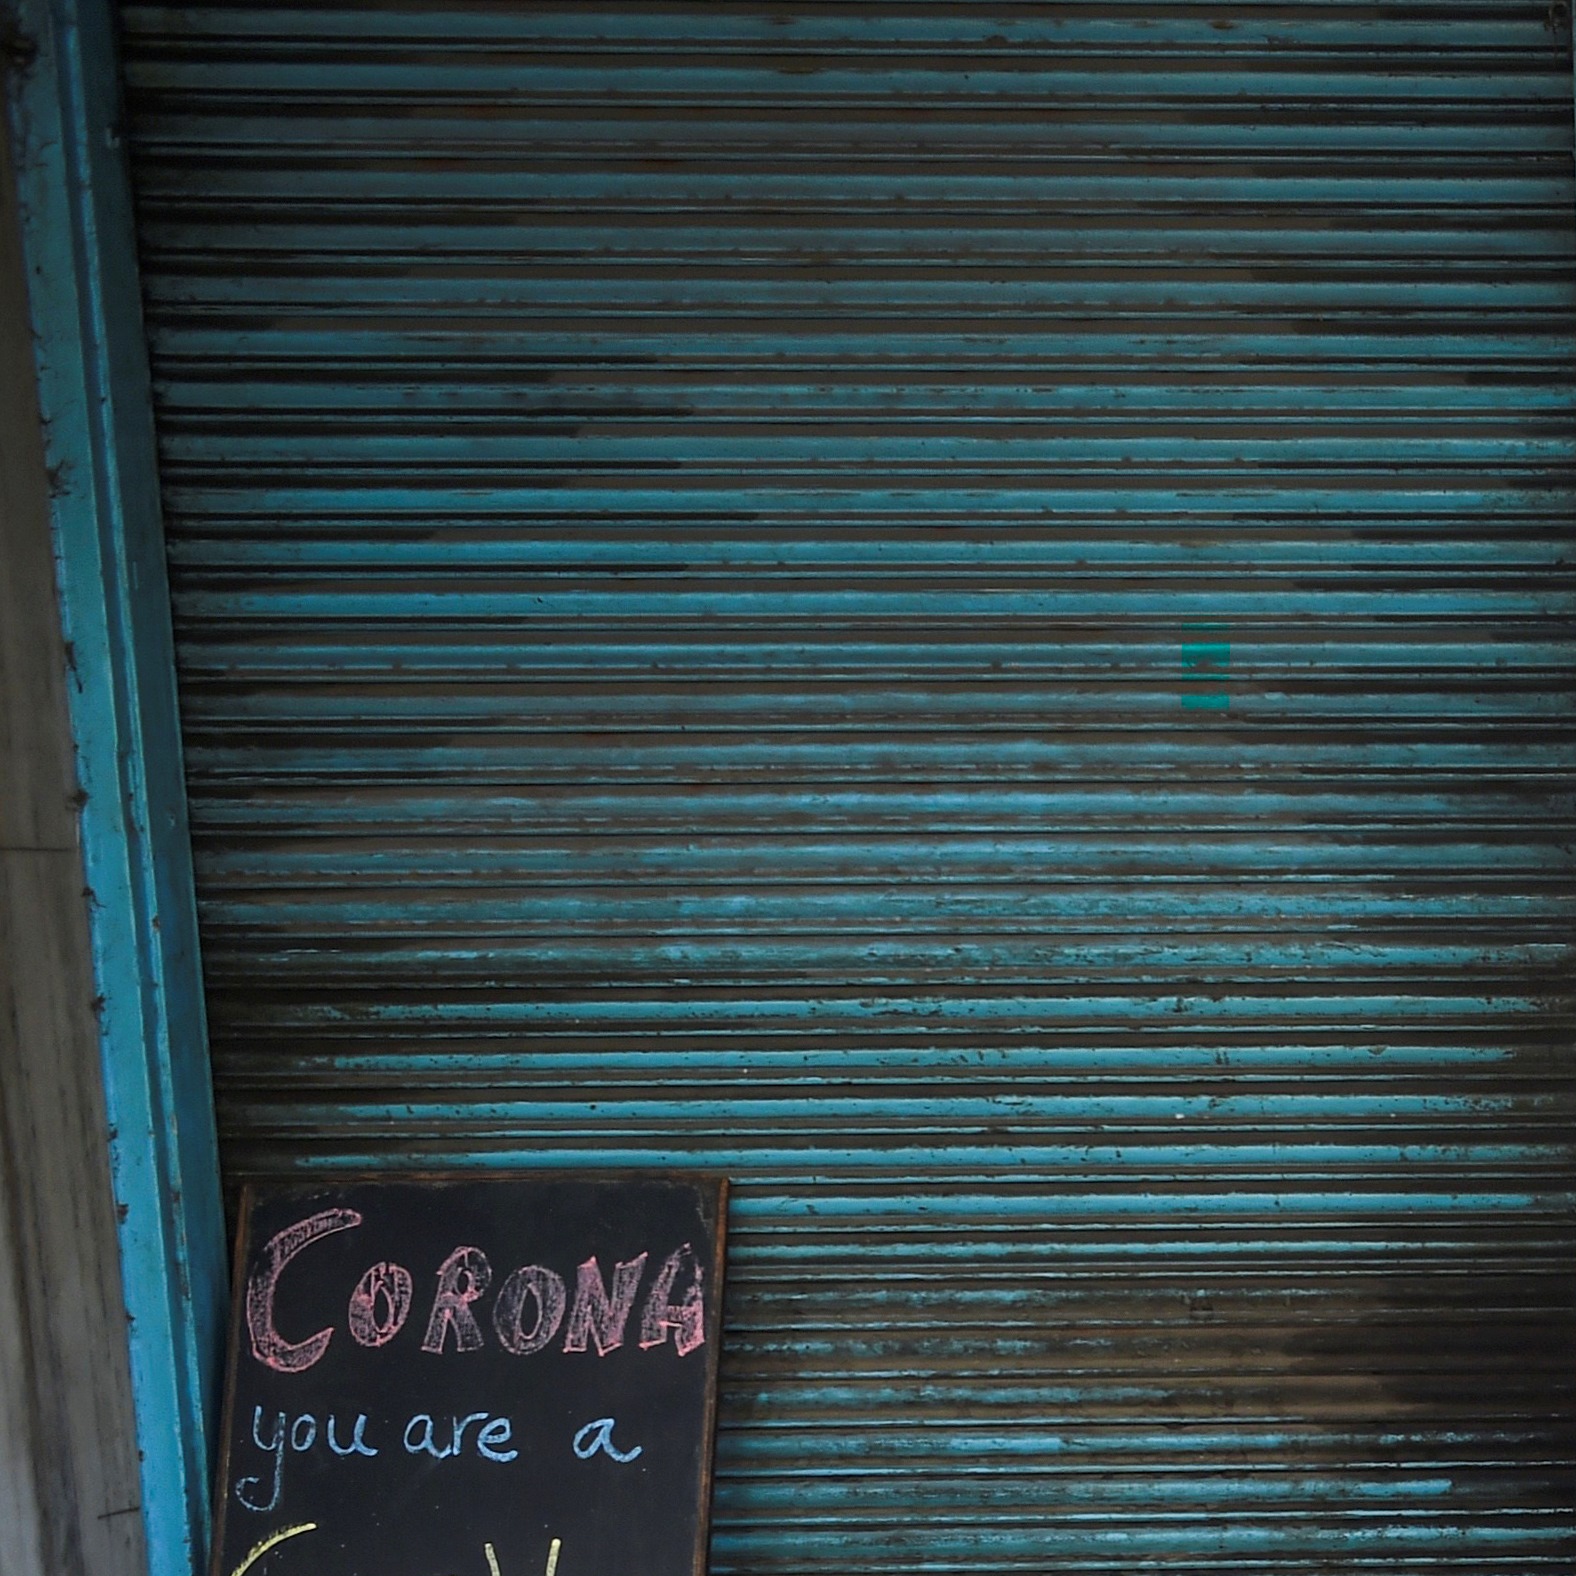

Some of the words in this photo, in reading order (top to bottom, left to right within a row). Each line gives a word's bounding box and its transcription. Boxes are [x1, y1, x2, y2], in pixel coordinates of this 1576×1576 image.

[246, 1207, 706, 1373] CORONA
[235, 1404, 378, 1512] you
[403, 1411, 518, 1463] are
[572, 1416, 643, 1464] a
